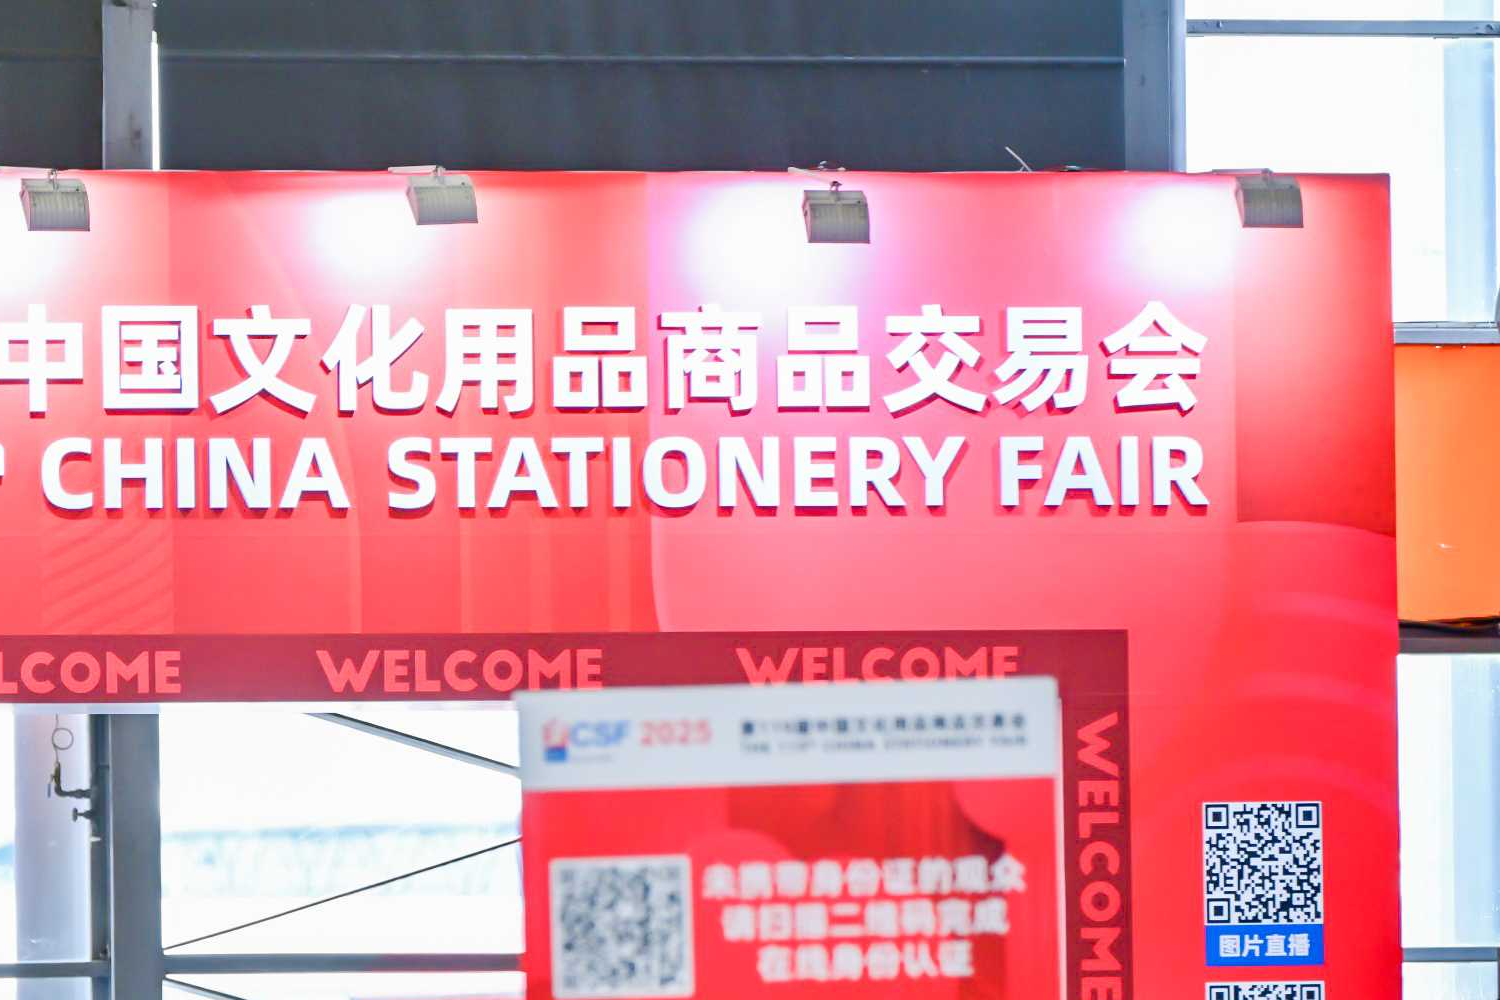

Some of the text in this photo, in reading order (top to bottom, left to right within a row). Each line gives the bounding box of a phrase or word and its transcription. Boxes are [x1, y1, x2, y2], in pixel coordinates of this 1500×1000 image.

[41, 437, 350, 509] CHINA
[388, 436, 966, 508] STATIONERY
[1001, 436, 1209, 507] FAIR
[316, 649, 603, 692] WELCOME
[736, 646, 1018, 687] WELCOME
[1219, 933, 1311, 958] 图片直播
